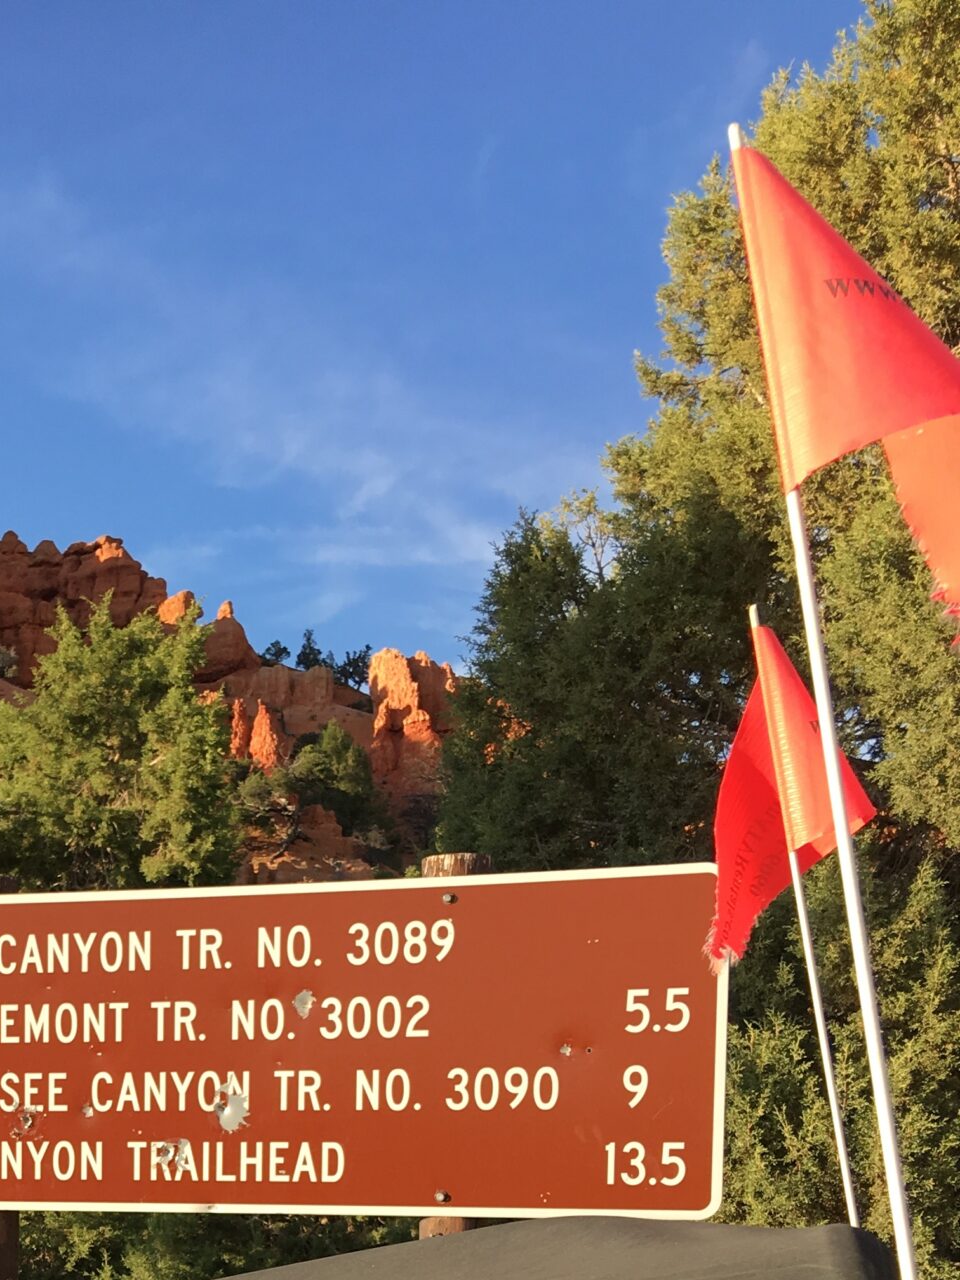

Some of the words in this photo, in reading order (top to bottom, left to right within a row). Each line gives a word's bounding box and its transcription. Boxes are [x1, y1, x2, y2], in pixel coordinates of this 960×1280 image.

[175, 928, 232, 970] TR.
[257, 924, 322, 968] NO.
[345, 919, 455, 966] 3089
[150, 1000, 206, 1042] TR.
[230, 998, 297, 1041] NO.
[319, 994, 430, 1040] 3002
[624, 987, 691, 1034] 5.5
[91, 1070, 251, 1114] CANYON
[273, 1069, 331, 1112] TR.
[355, 1068, 422, 1112] NO.
[445, 1066, 560, 1111] 3090
[622, 1064, 649, 1109] 9
[126, 1138, 345, 1183] TRAILHEAD
[605, 1141, 686, 1187] 13.5
